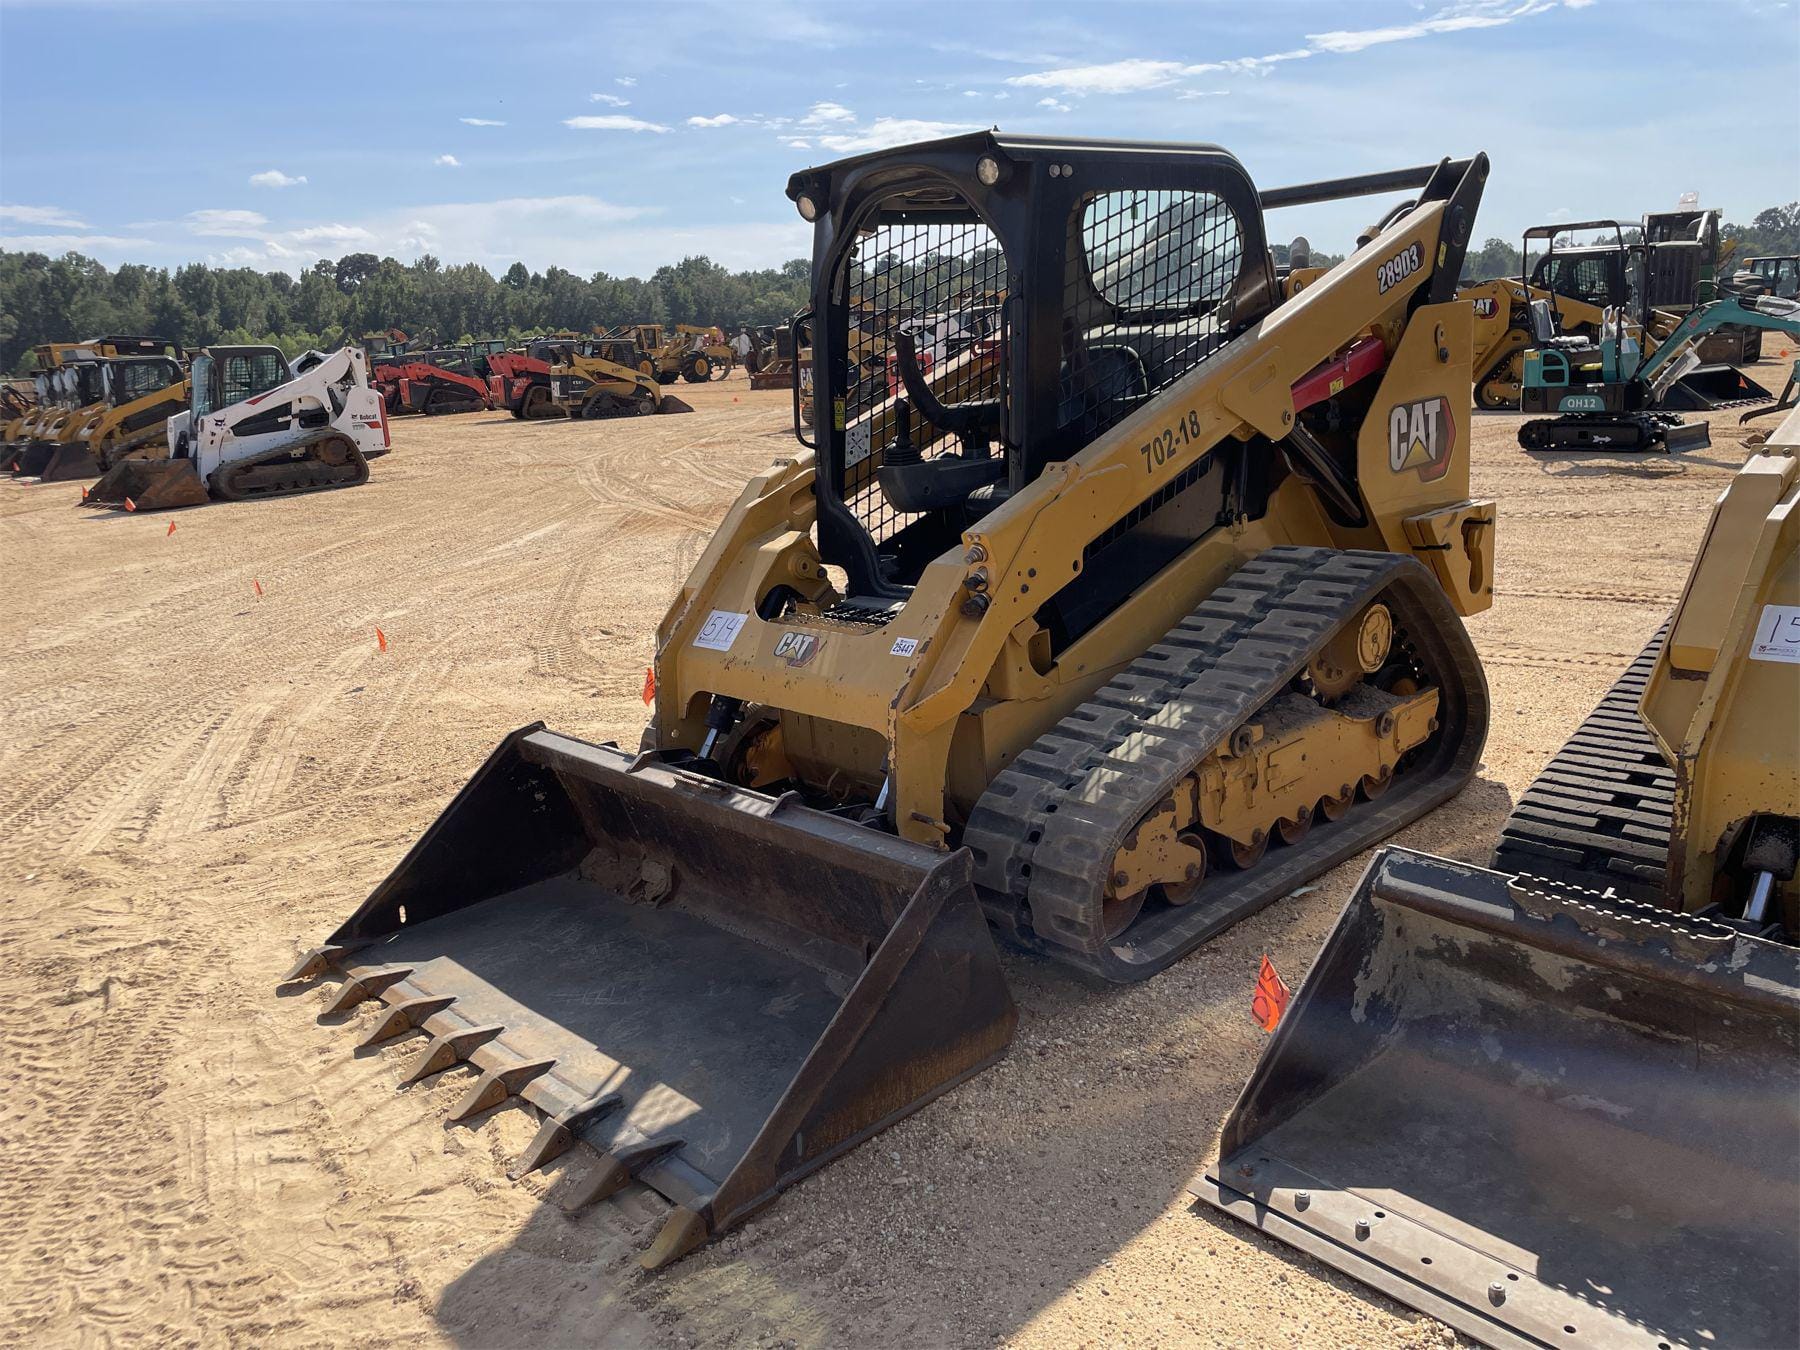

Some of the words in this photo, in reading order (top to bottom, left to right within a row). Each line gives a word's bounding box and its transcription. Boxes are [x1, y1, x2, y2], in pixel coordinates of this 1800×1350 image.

[1377, 243, 1419, 295] 289D3
[800, 367, 814, 390] CA
[1140, 409, 1201, 474] 702-18
[1390, 398, 1441, 471] CAT
[699, 614, 741, 642] 1514
[774, 632, 815, 660] CAT
